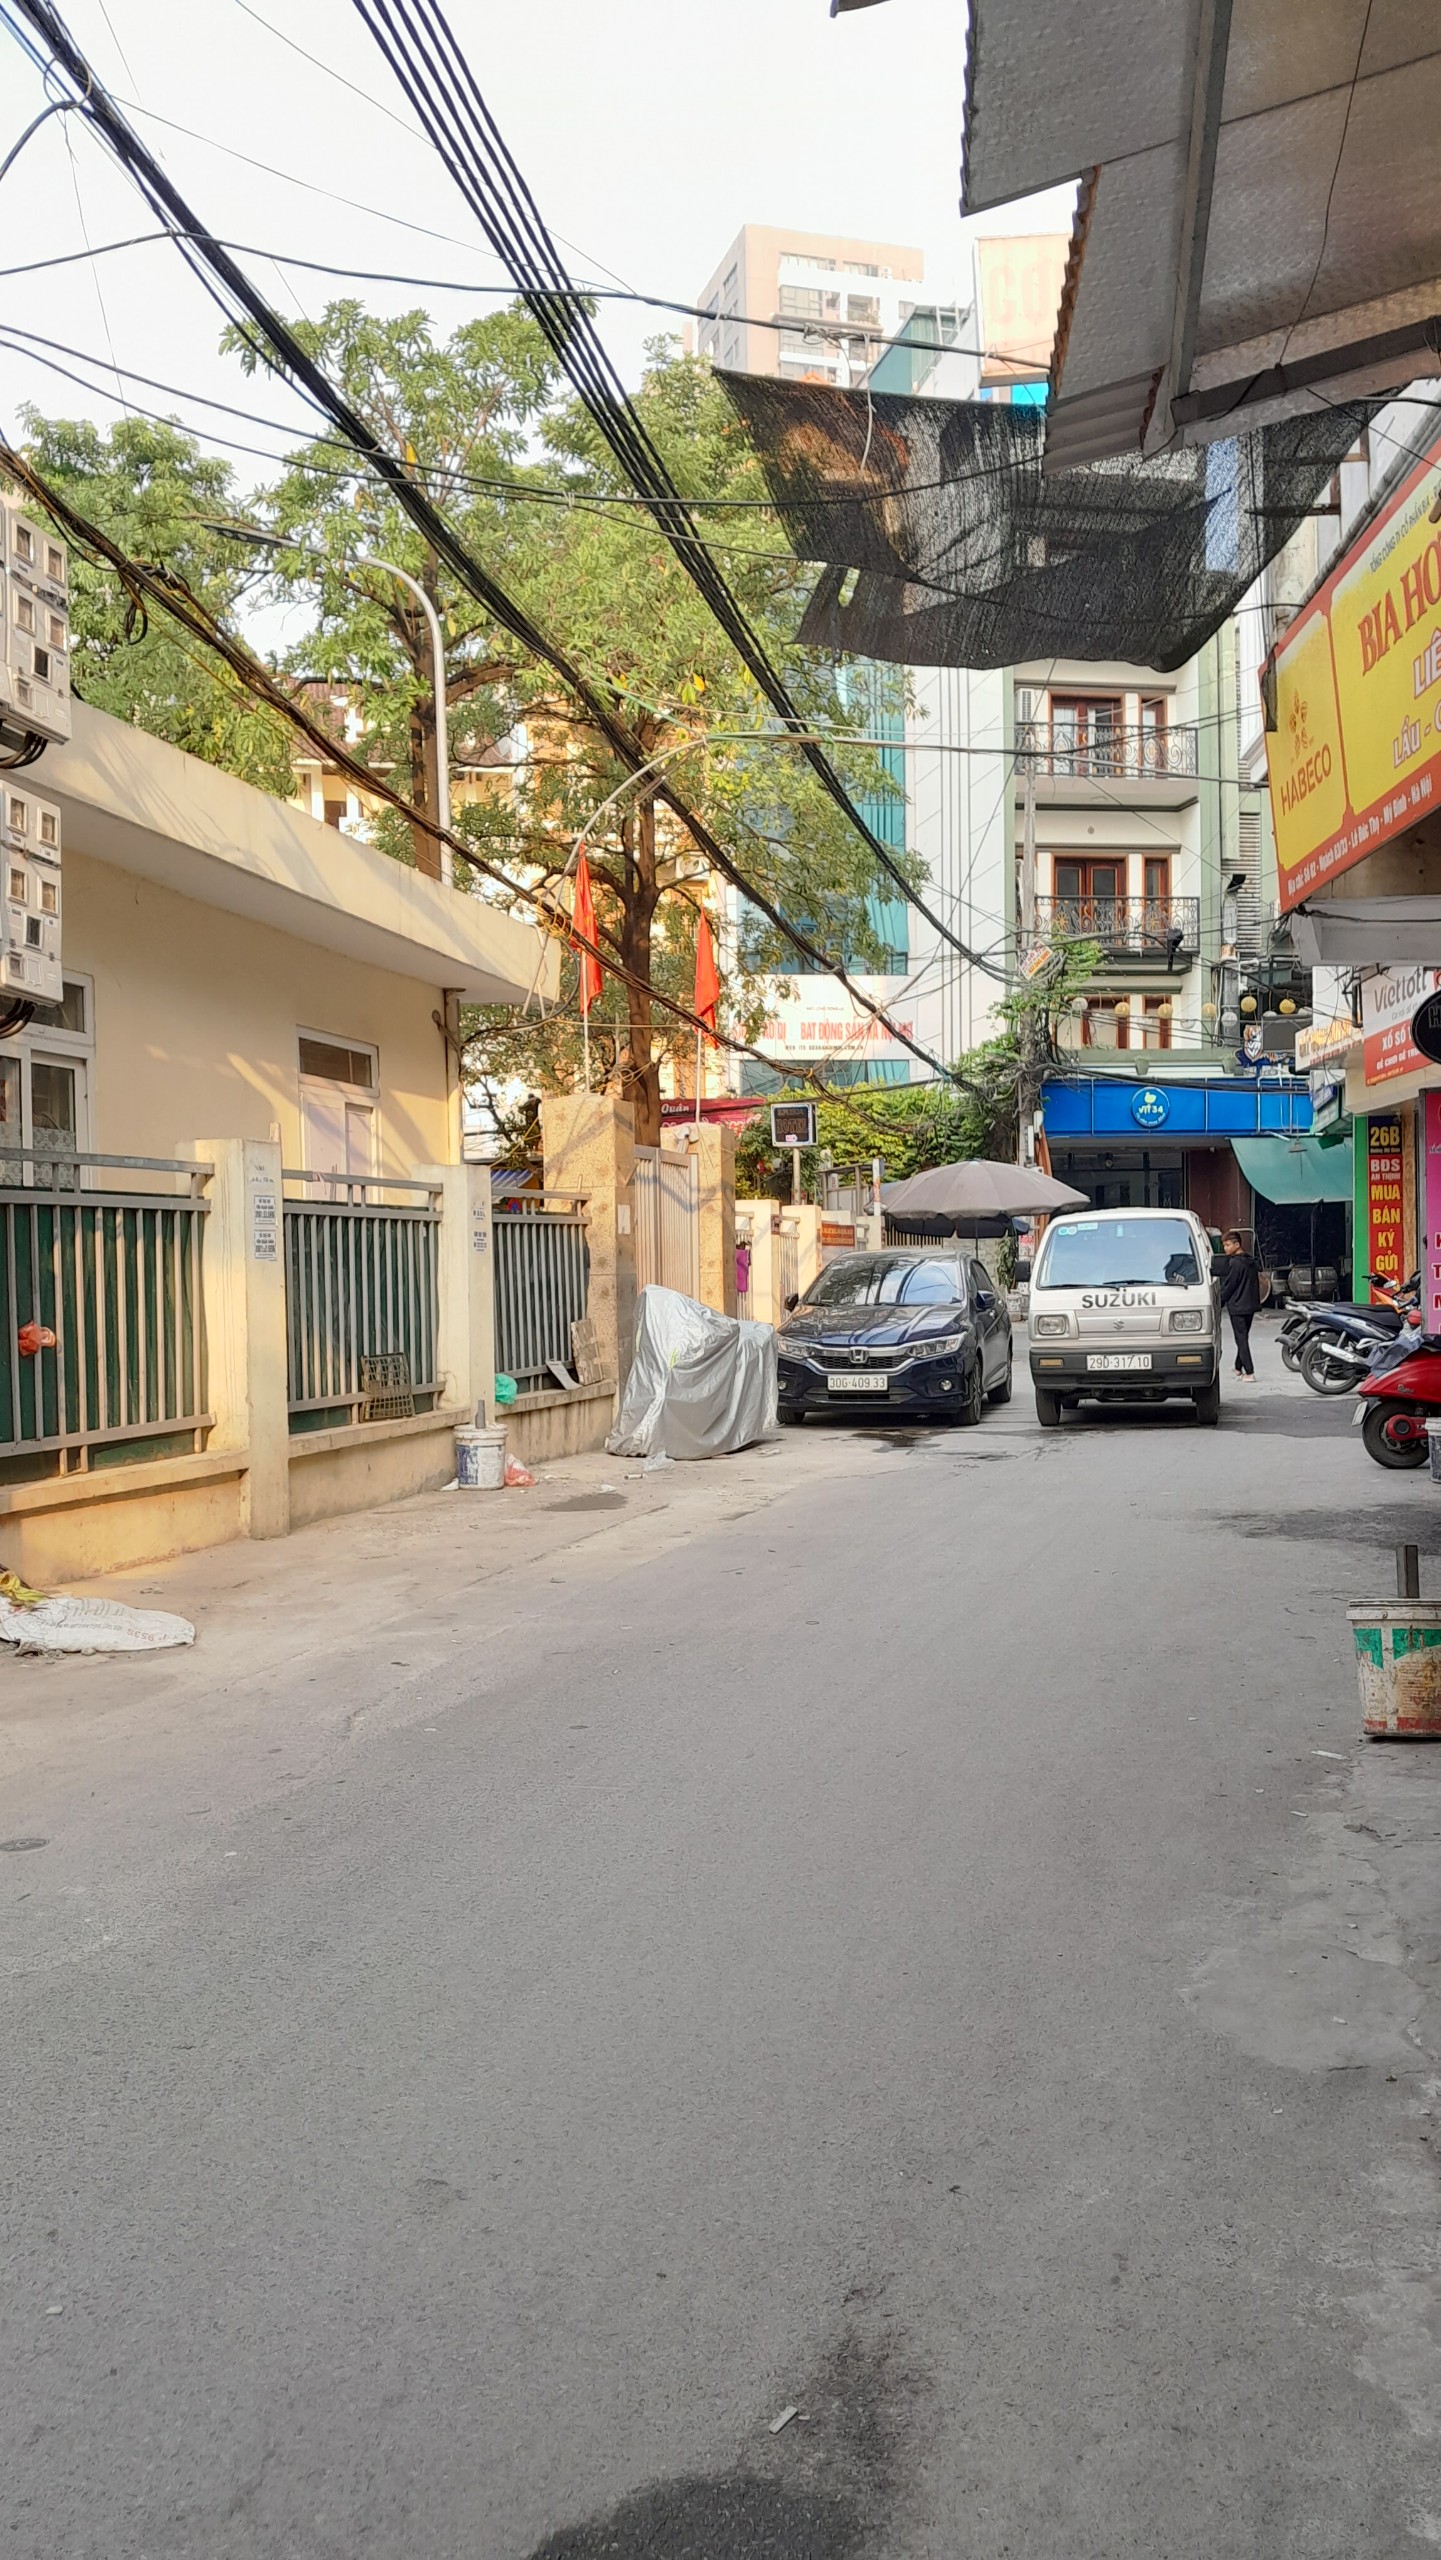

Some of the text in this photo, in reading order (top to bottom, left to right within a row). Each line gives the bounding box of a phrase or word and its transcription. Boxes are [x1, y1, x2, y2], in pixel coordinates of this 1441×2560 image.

[1357, 588, 1403, 677] BIA
[1280, 743, 1332, 817] HABECO
[1370, 1126, 1400, 1147] 26B
[1371, 1184, 1400, 1201] MUA
[1372, 1205, 1400, 1224] BÁN
[1377, 1228, 1395, 1248] KÝ
[1375, 1249, 1398, 1271] GỬI
[1081, 1291, 1157, 1309] SUZUKI
